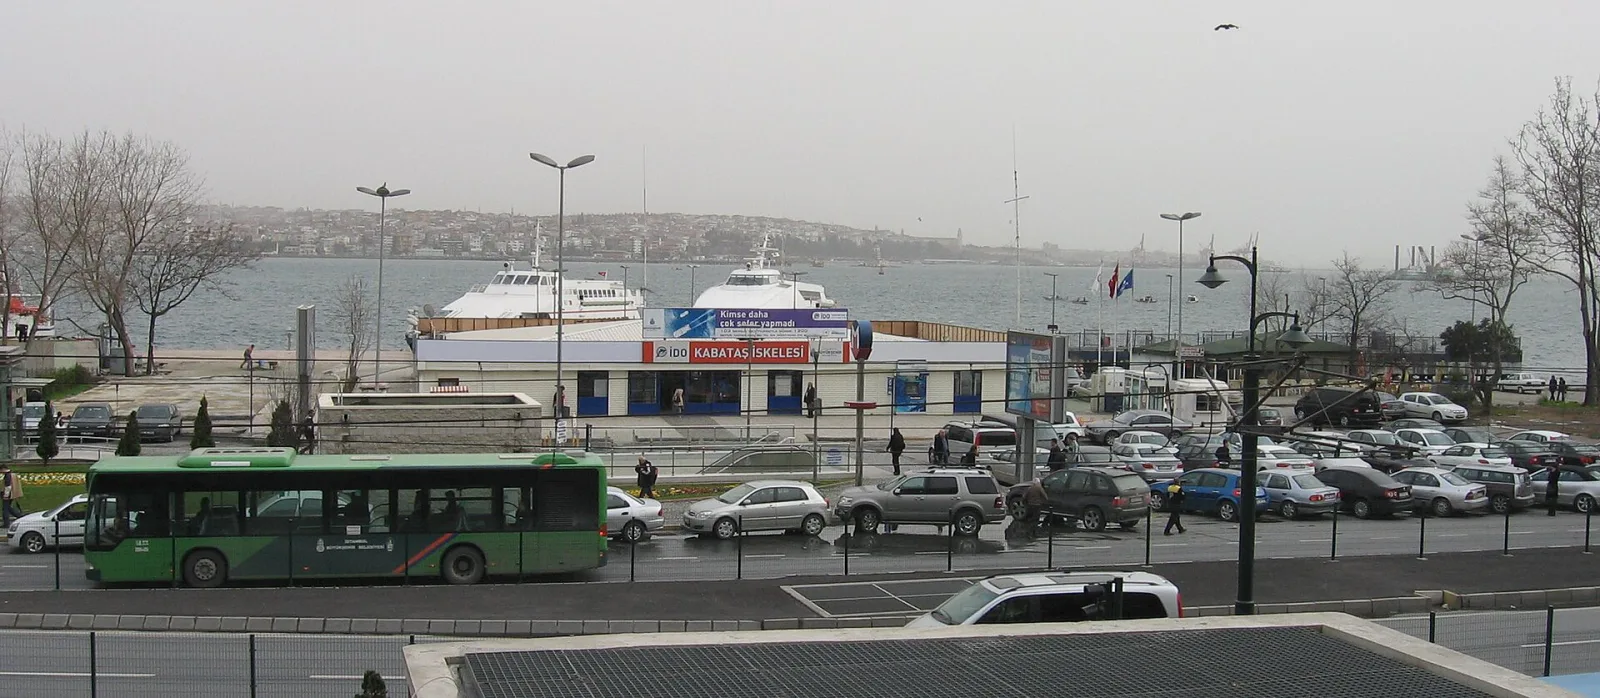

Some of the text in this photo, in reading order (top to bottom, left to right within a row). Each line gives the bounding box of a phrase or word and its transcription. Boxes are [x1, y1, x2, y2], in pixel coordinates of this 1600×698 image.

[720, 310, 769, 318] Kimse daha
[720, 319, 735, 328] çok
[760, 319, 795, 329] yapmadı
[669, 346, 688, 358] İDO
[694, 345, 804, 359] KABATAŞ İSKELESİ
